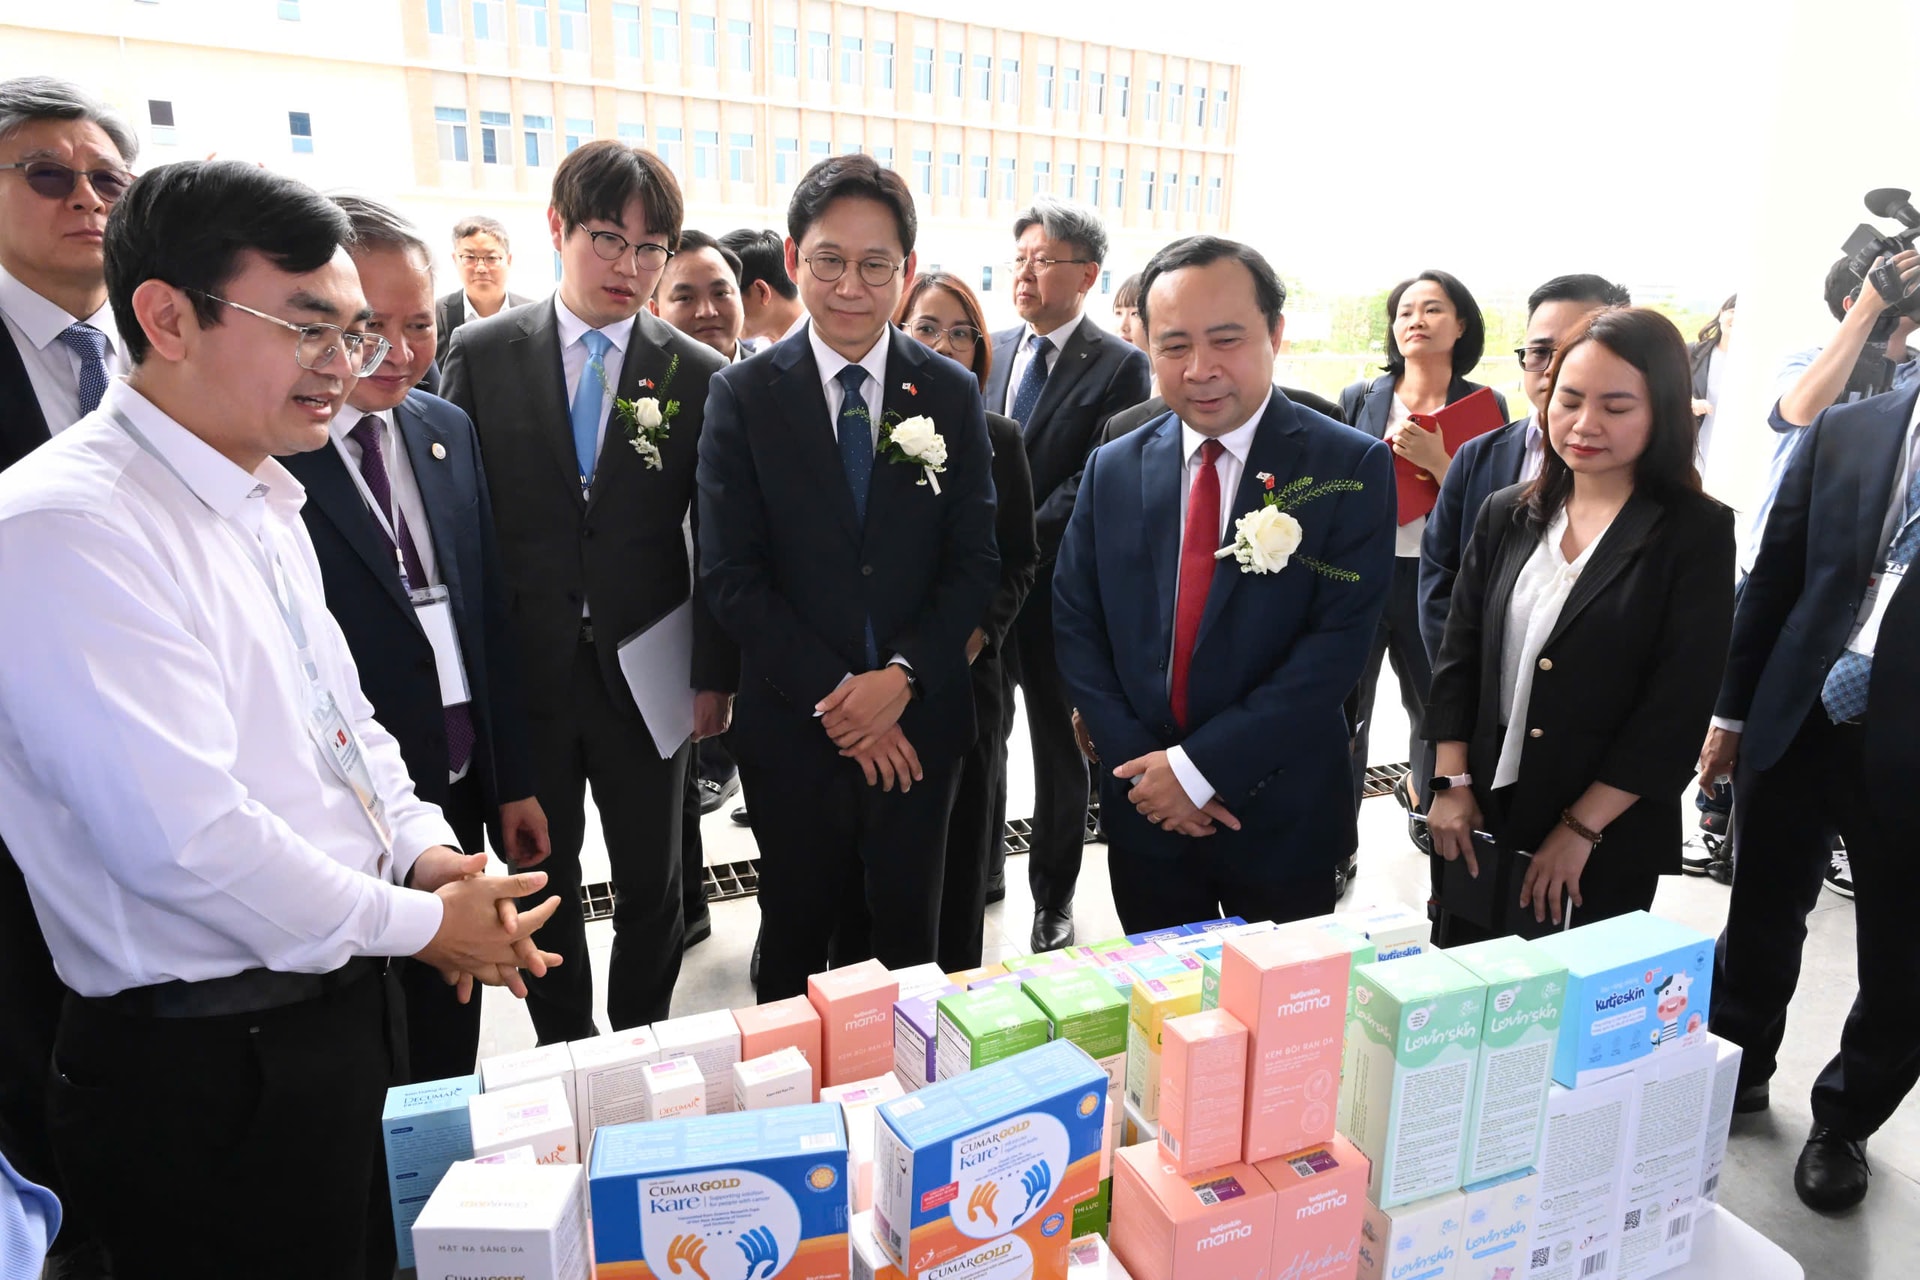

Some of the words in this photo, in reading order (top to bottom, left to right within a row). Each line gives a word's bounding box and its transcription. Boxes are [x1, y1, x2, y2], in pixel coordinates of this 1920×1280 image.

[1277, 995, 1331, 1018] mama
[1595, 987, 1645, 1012] kutieskin
[845, 1012, 886, 1032] mama
[1265, 1049, 1282, 1059] KEM
[1322, 1037, 1334, 1046] DA
[404, 1089, 458, 1104] DECUMAR
[659, 1098, 699, 1115] DECUMAR
[960, 1120, 1030, 1155] CUMARGOLD
[960, 1145, 999, 1171] Kare
[649, 1178, 741, 1197] CUMARGOLD
[650, 1195, 700, 1214] Kare
[1296, 1194, 1347, 1220] mama
[1197, 1224, 1252, 1252] mama
[928, 1243, 1012, 1280] CUMARGOLD
